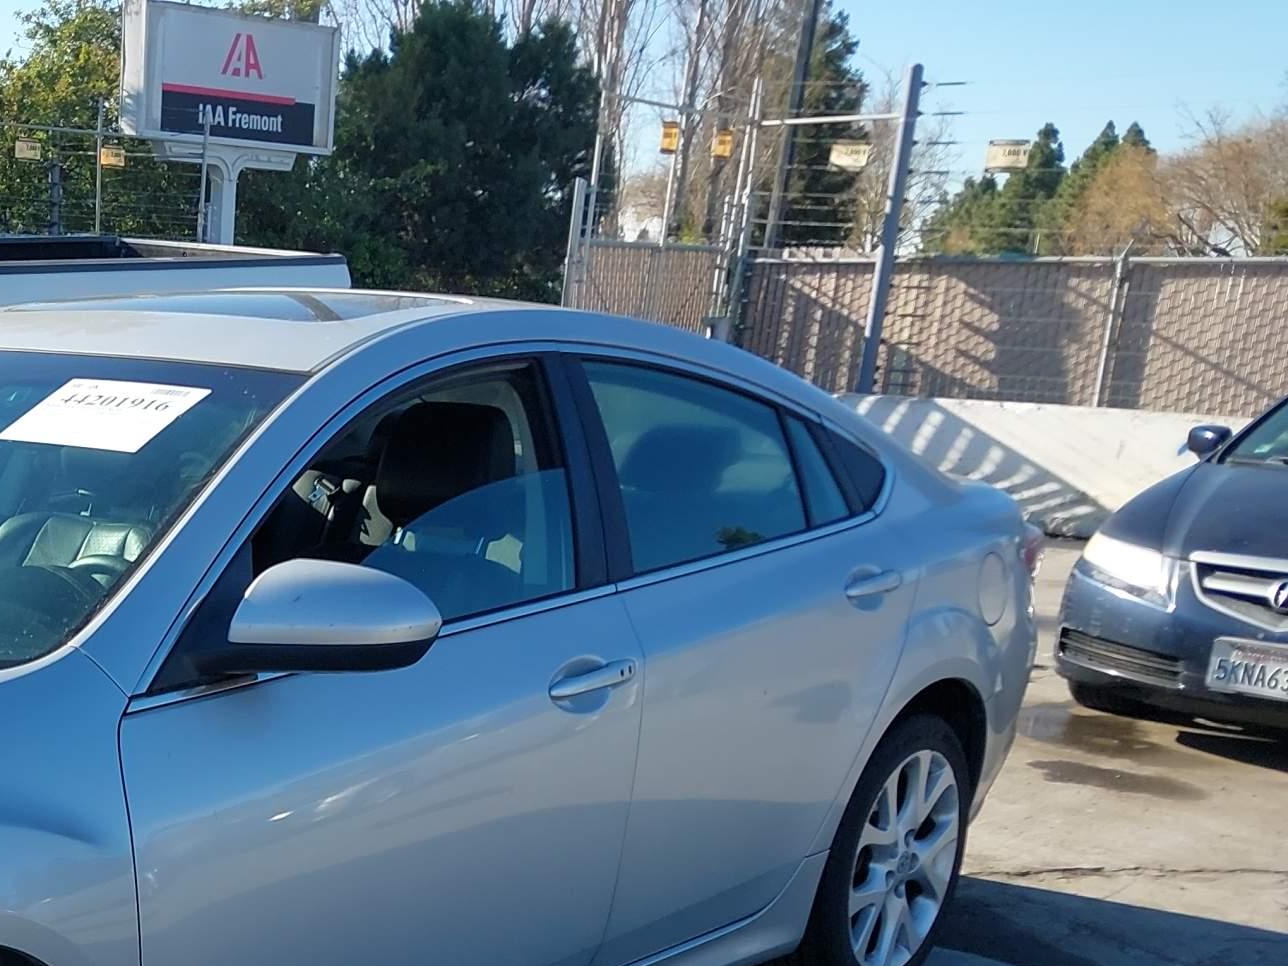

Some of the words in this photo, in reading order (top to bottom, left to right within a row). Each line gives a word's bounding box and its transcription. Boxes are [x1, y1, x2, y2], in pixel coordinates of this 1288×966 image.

[198, 103, 224, 126] IAA
[228, 106, 282, 133] Fremont
[61, 392, 171, 412] 44201916
